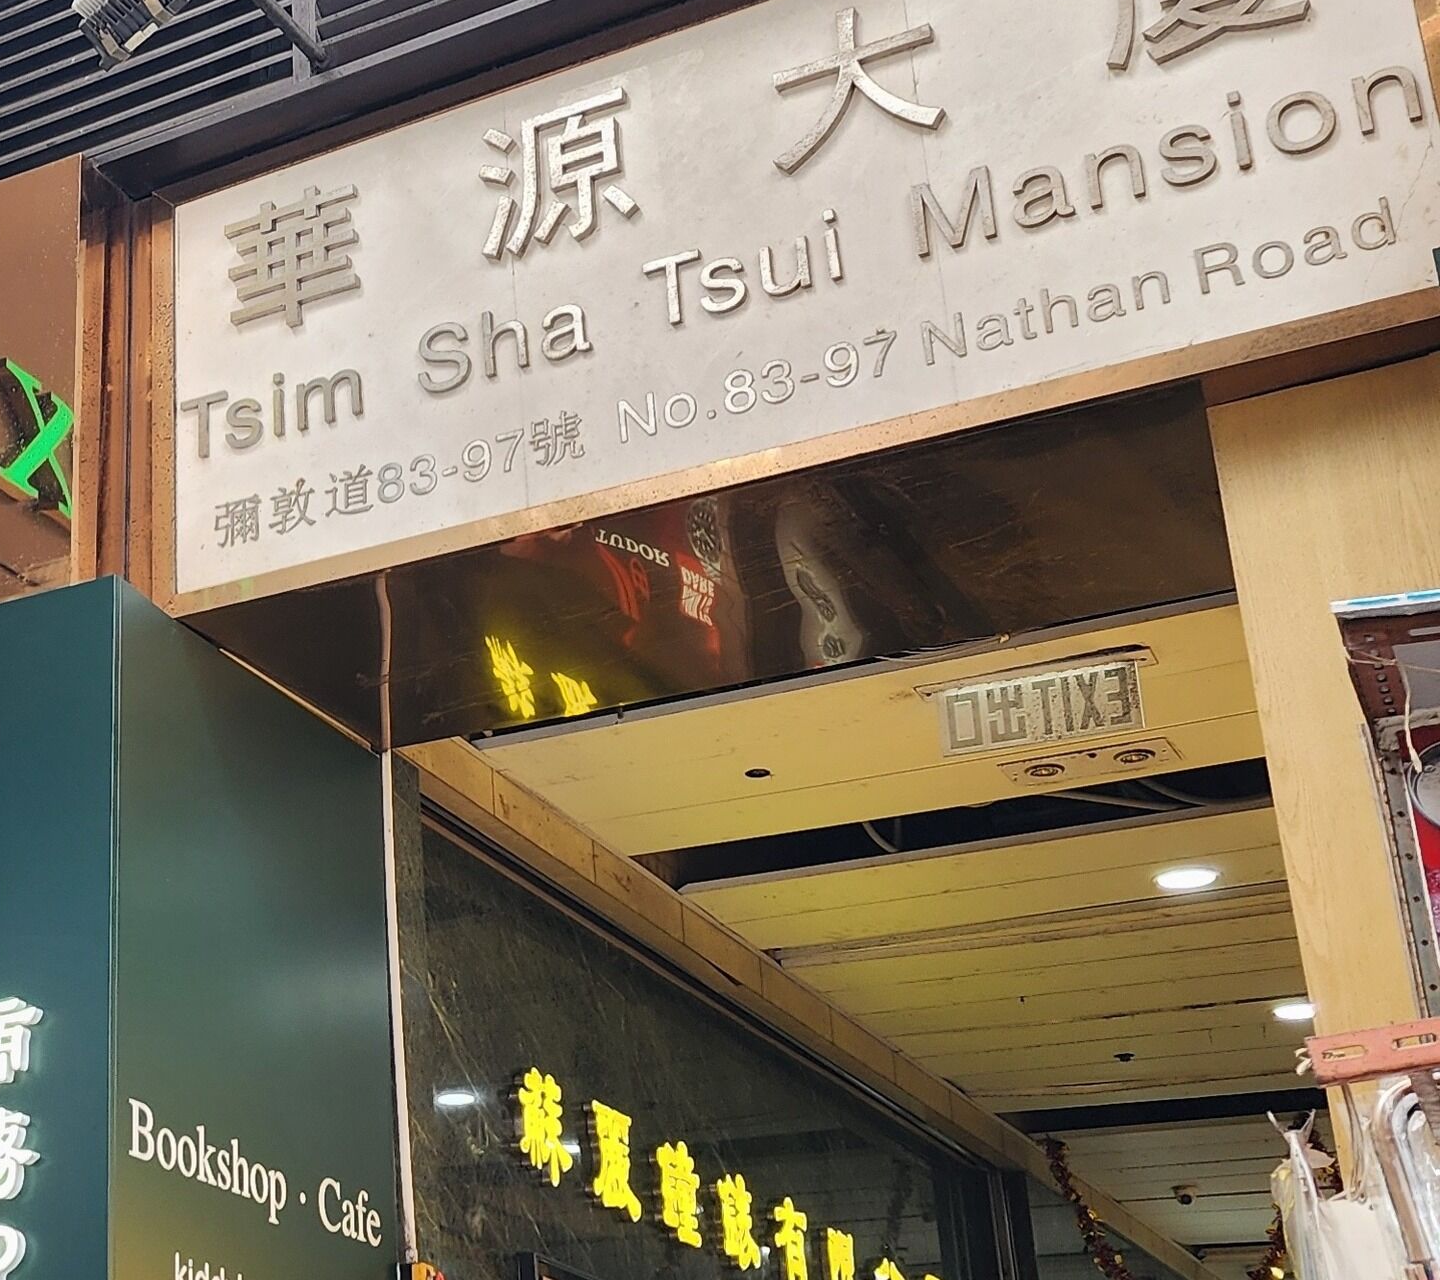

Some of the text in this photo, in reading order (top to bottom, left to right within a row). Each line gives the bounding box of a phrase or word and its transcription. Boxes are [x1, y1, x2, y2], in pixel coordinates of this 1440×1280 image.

[179, 64, 1425, 460] Tsim Sha Tsui Mansion
[920, 267, 1172, 368] Nathan
[1193, 194, 1398, 296] Road
[212, 410, 585, 549] 彌敦道83-97號
[127, 1097, 383, 1248] Bookshop Cafe
